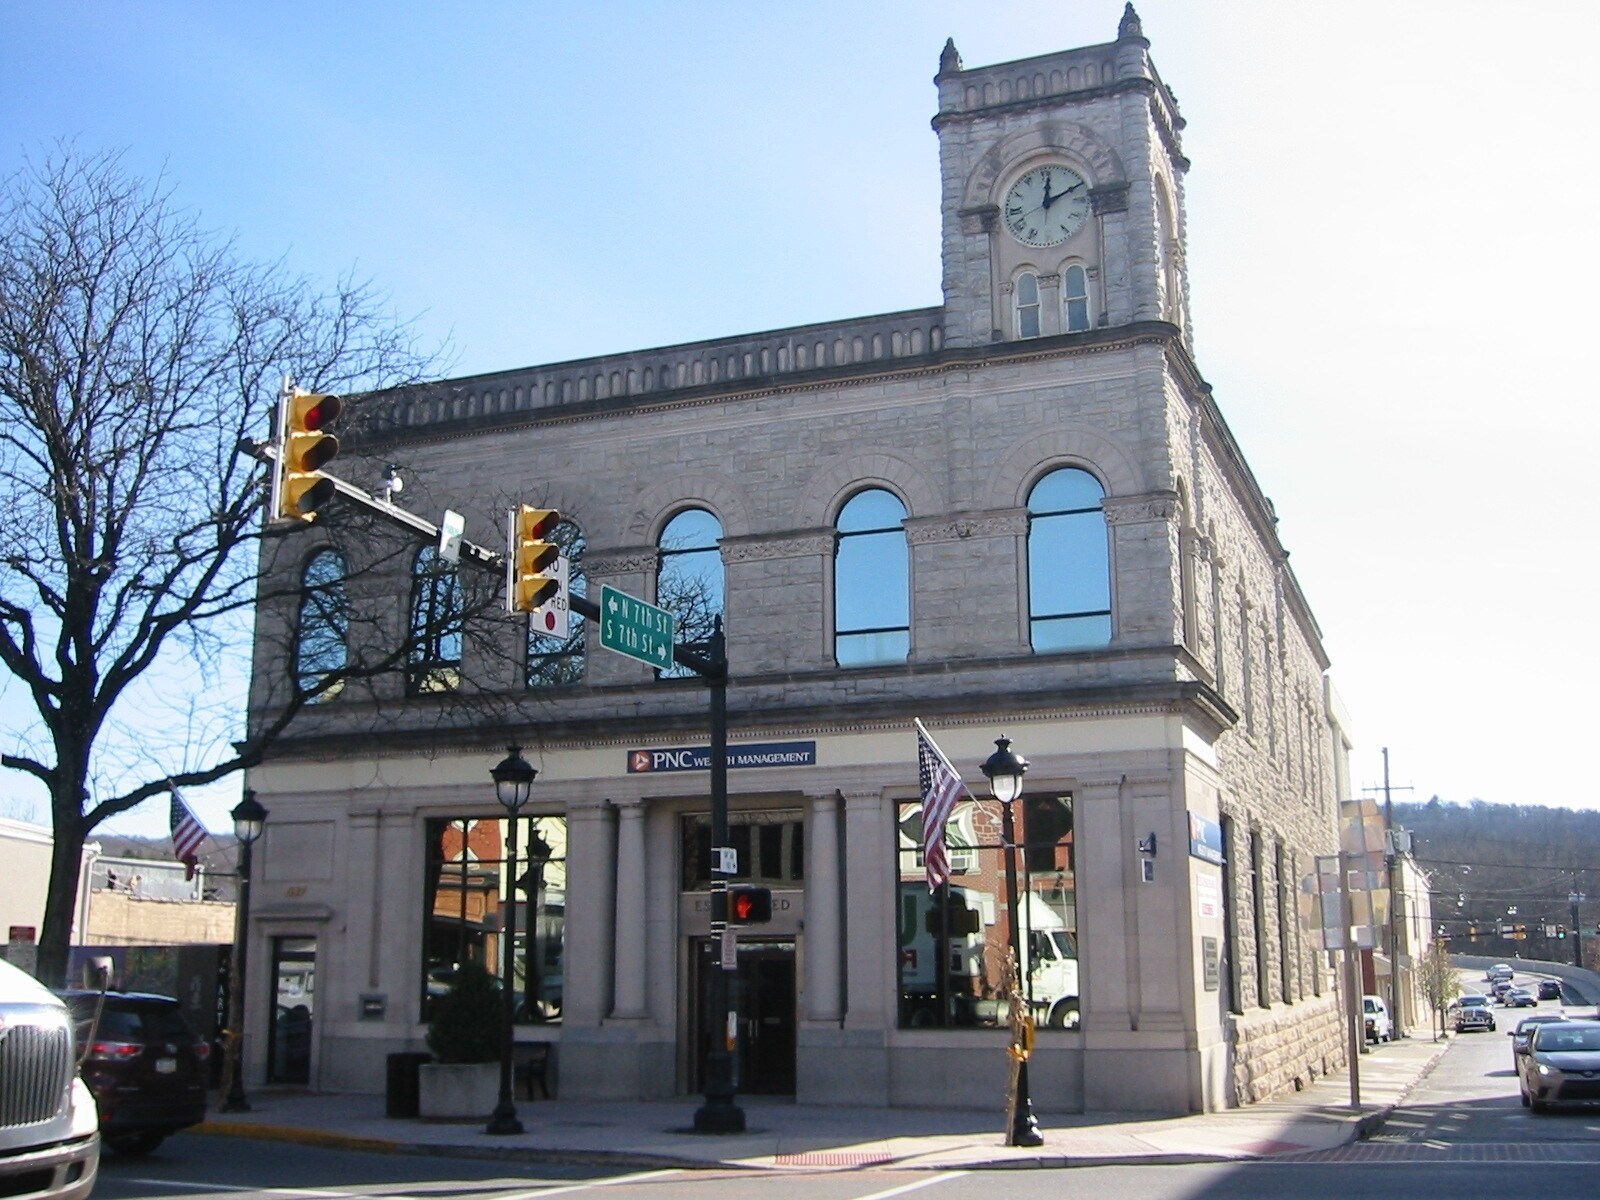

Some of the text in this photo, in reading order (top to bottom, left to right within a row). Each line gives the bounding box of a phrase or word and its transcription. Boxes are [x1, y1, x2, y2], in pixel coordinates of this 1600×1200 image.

[622, 599, 629, 619] N
[606, 619, 613, 639] S
[652, 750, 693, 769] PNC
[737, 751, 810, 765] MANAGEMENT
